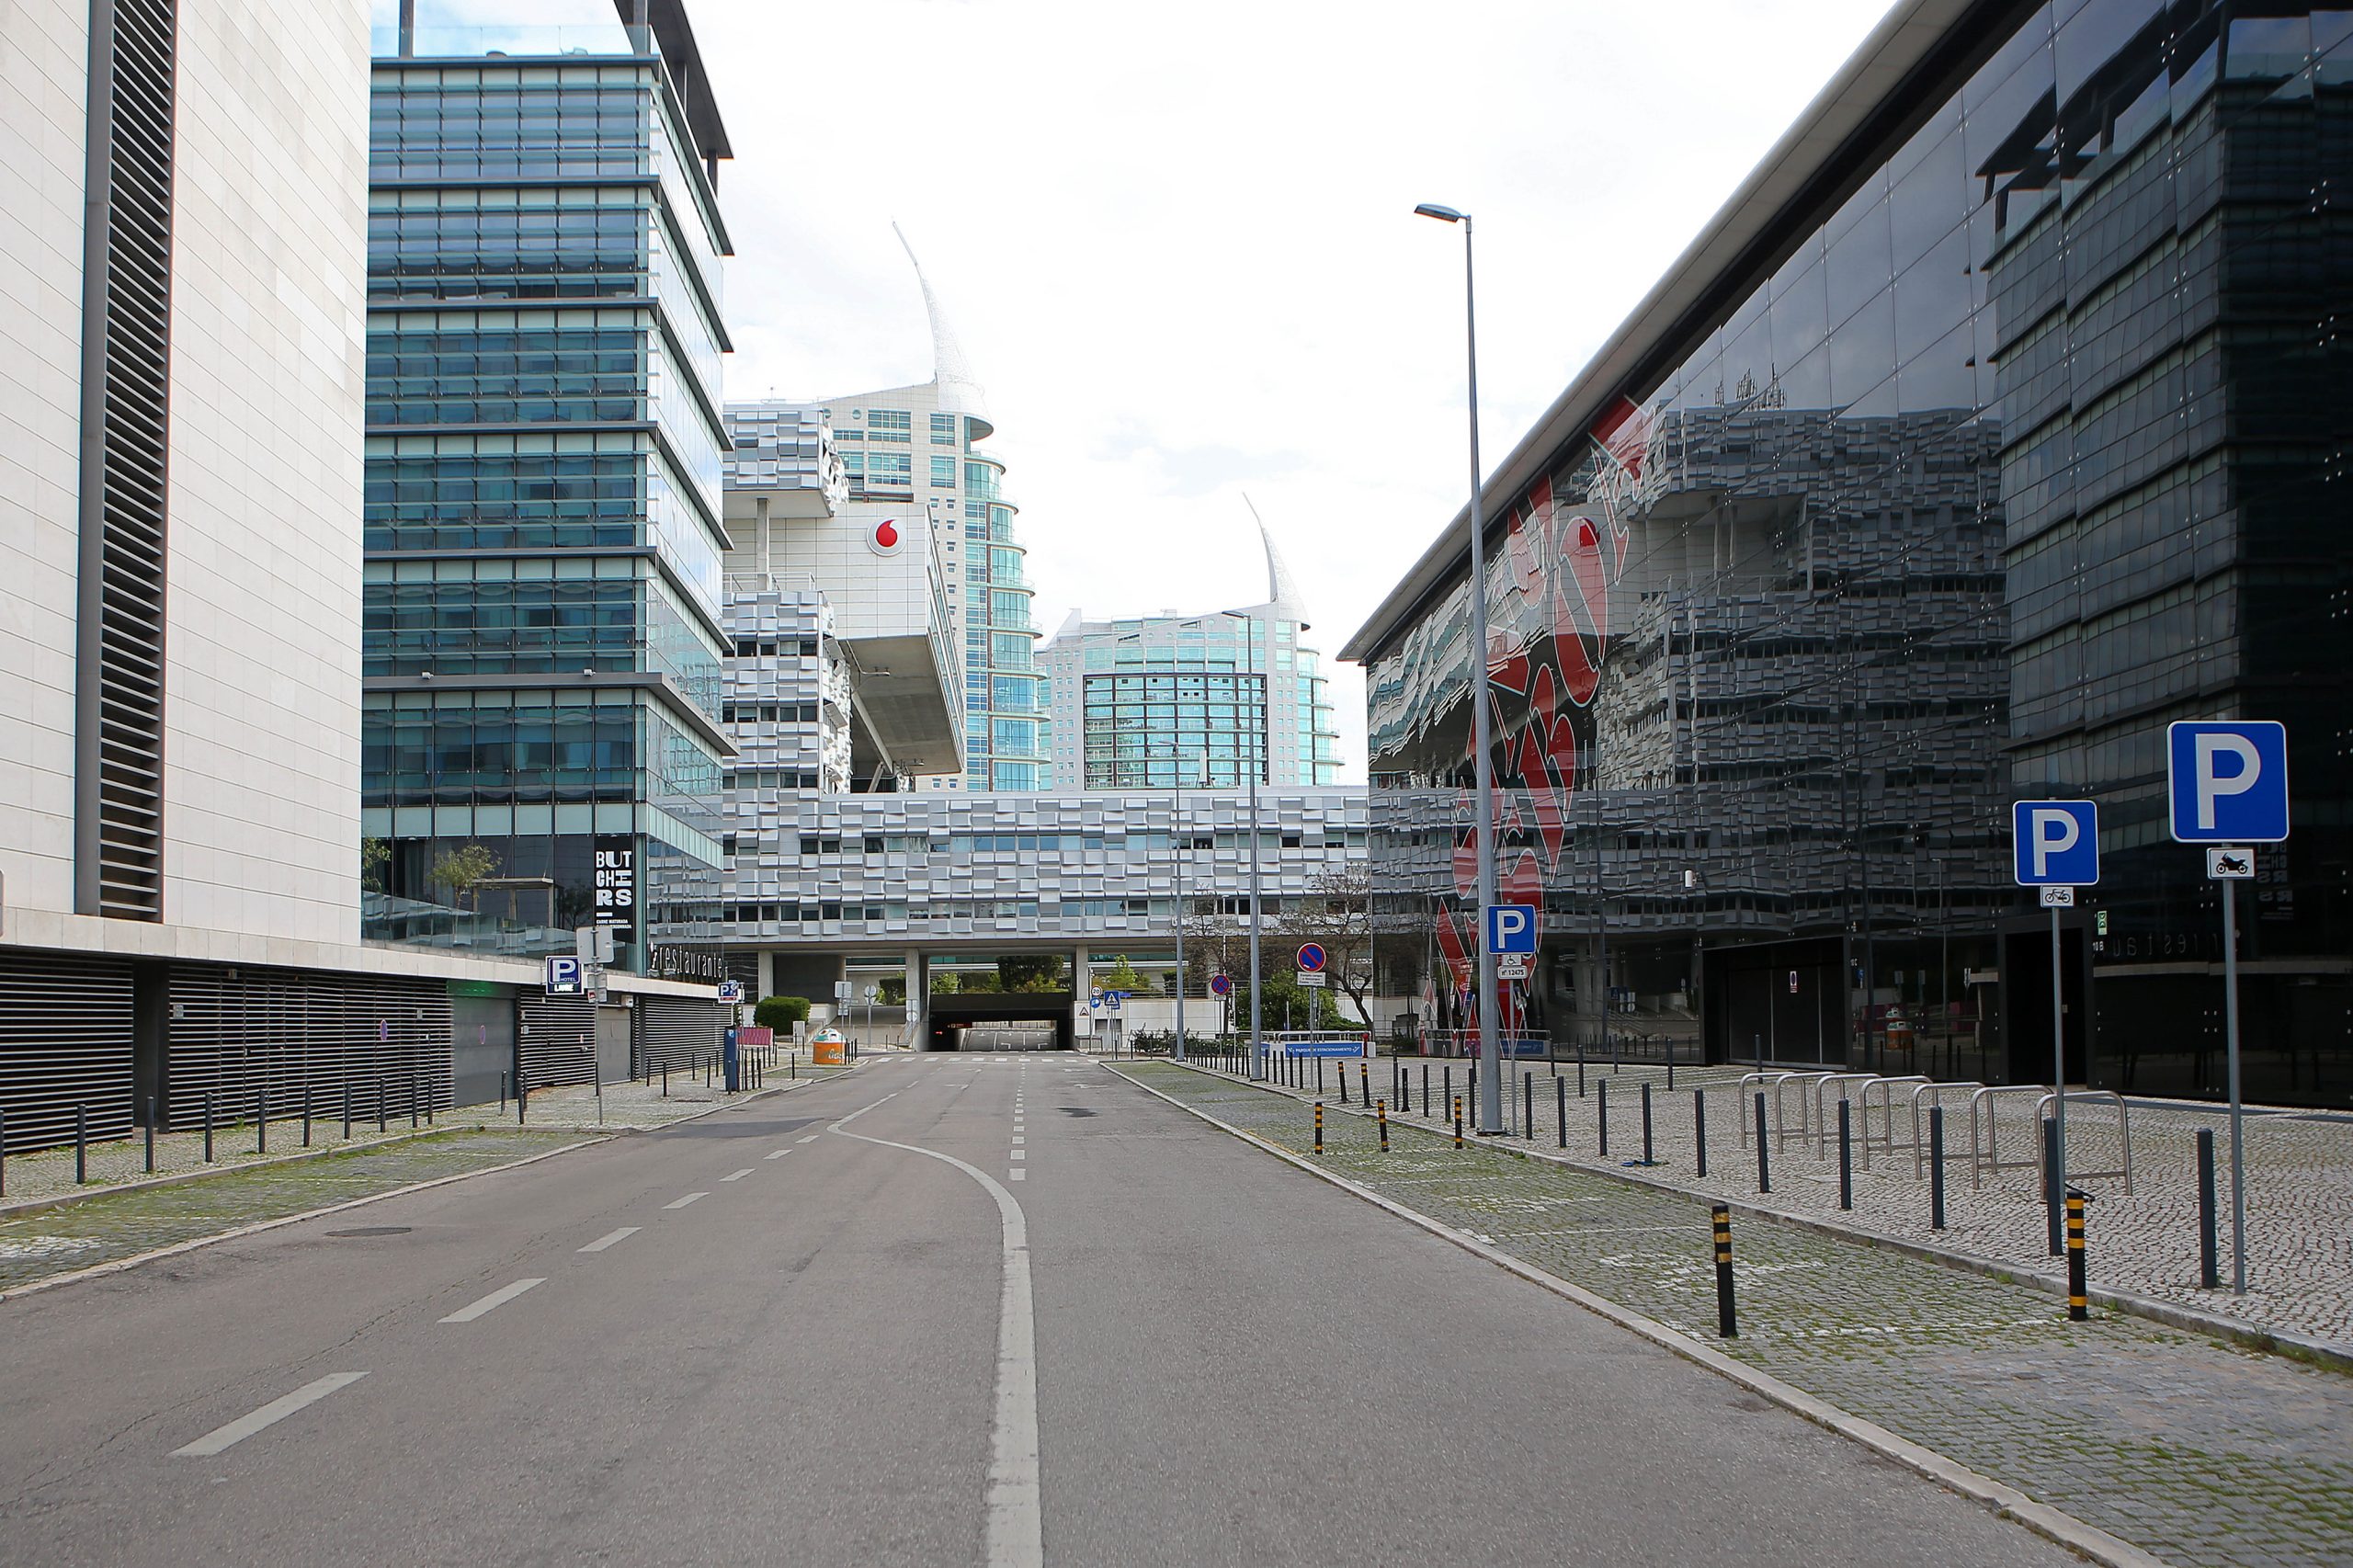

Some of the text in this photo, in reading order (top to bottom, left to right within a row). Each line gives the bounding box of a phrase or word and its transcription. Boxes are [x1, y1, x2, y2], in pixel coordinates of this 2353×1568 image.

[2195, 733, 2261, 829] P
[2031, 809, 2079, 876] P
[596, 851, 631, 868] BUT
[596, 889, 631, 906] RS
[1496, 910, 1526, 949] P
[552, 960, 576, 983] P
[659, 945, 722, 979] restaurante
[554, 983, 574, 992] LIVRE
[721, 984, 730, 996] P
